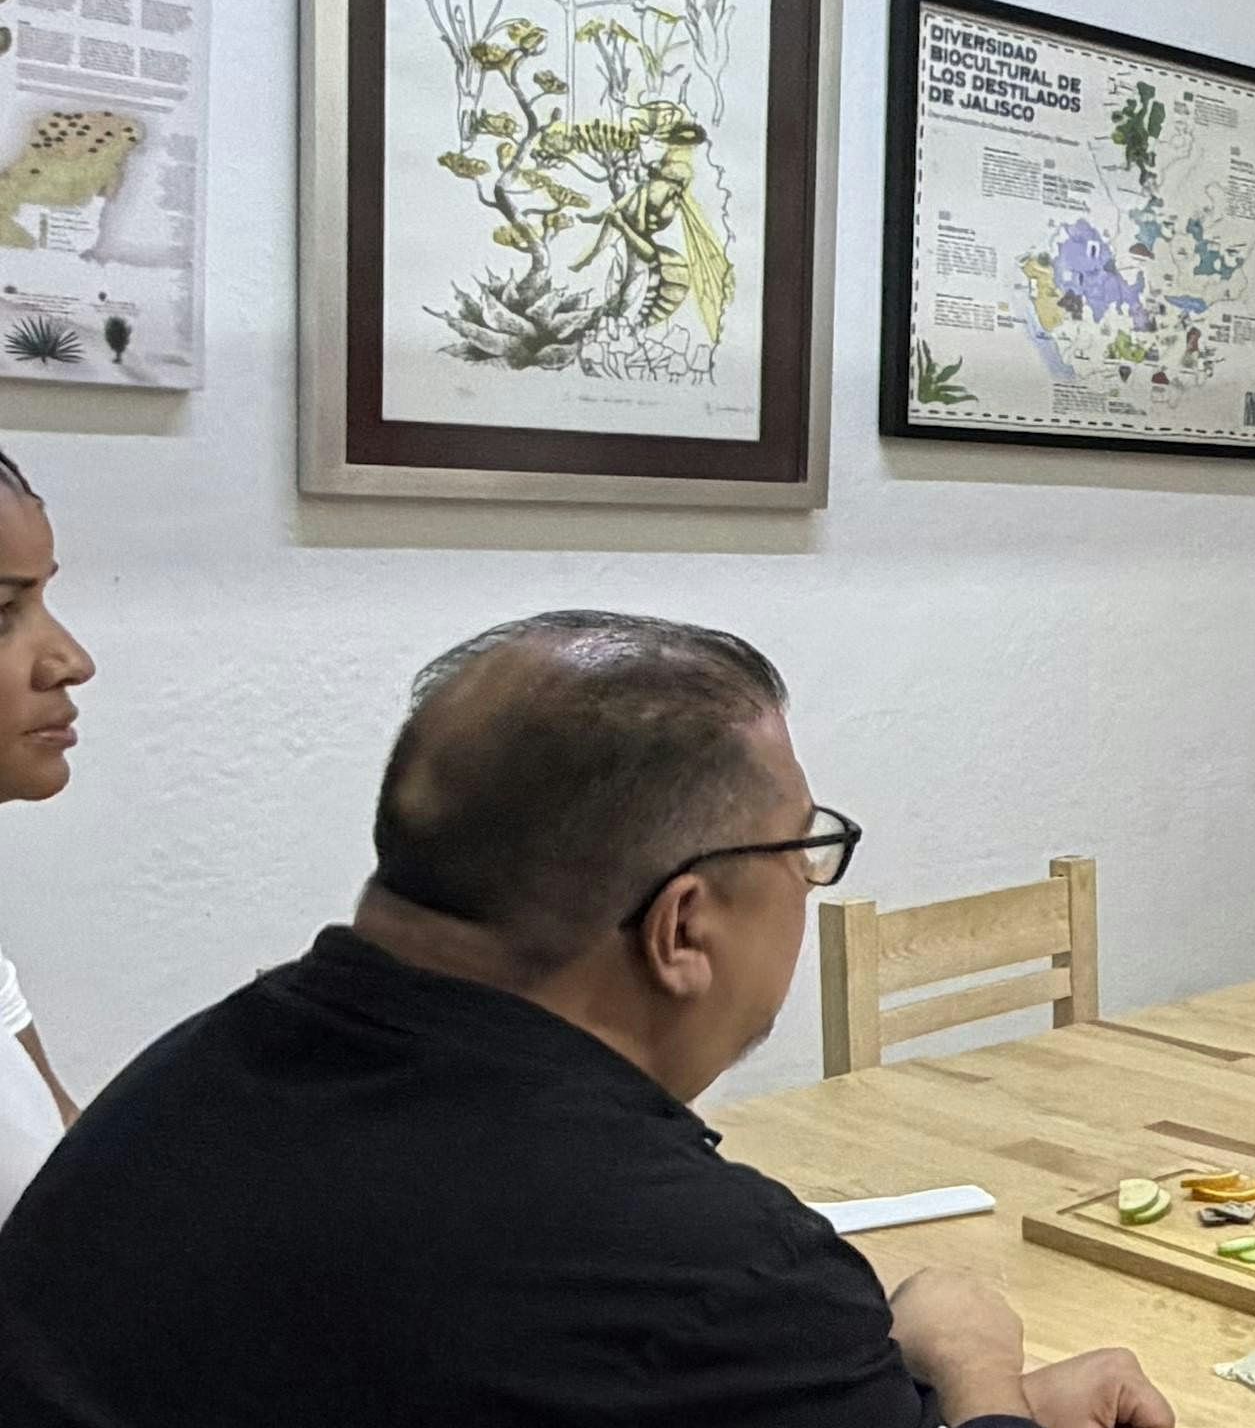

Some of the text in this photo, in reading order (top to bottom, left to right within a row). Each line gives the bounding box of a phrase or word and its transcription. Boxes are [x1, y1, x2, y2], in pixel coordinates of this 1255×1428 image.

[930, 24, 1037, 64] DIVERSIDAD
[929, 65, 1081, 113] LOS DESTILADOS
[930, 45, 1081, 94] BIOCULTURAL DE
[928, 86, 954, 105] DE
[959, 93, 1035, 122] JALISCO
